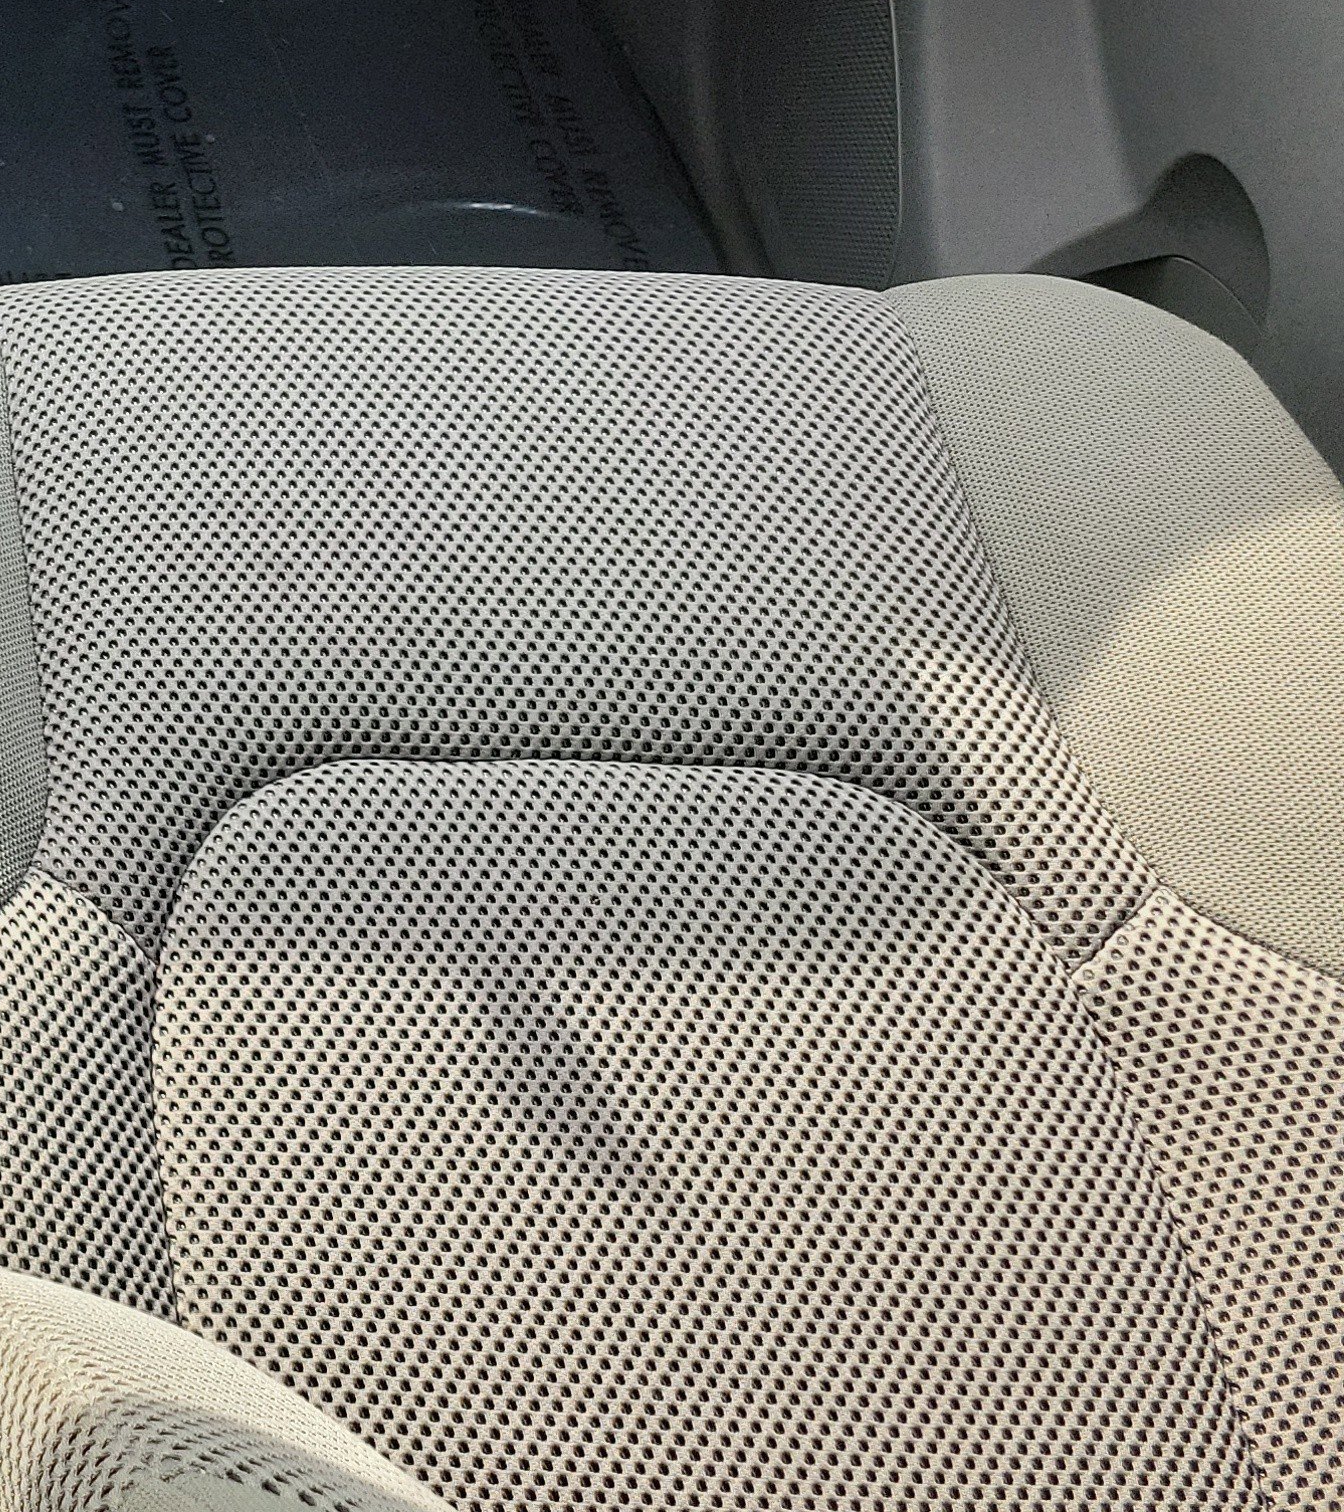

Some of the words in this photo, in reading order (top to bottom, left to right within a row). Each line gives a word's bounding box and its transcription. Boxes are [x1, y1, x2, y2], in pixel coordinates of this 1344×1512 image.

[145, 45, 193, 124] COVER
[123, 104, 169, 167] MUST
[150, 181, 199, 269] DEALER
[170, 132, 237, 268] ROTECTIVE
